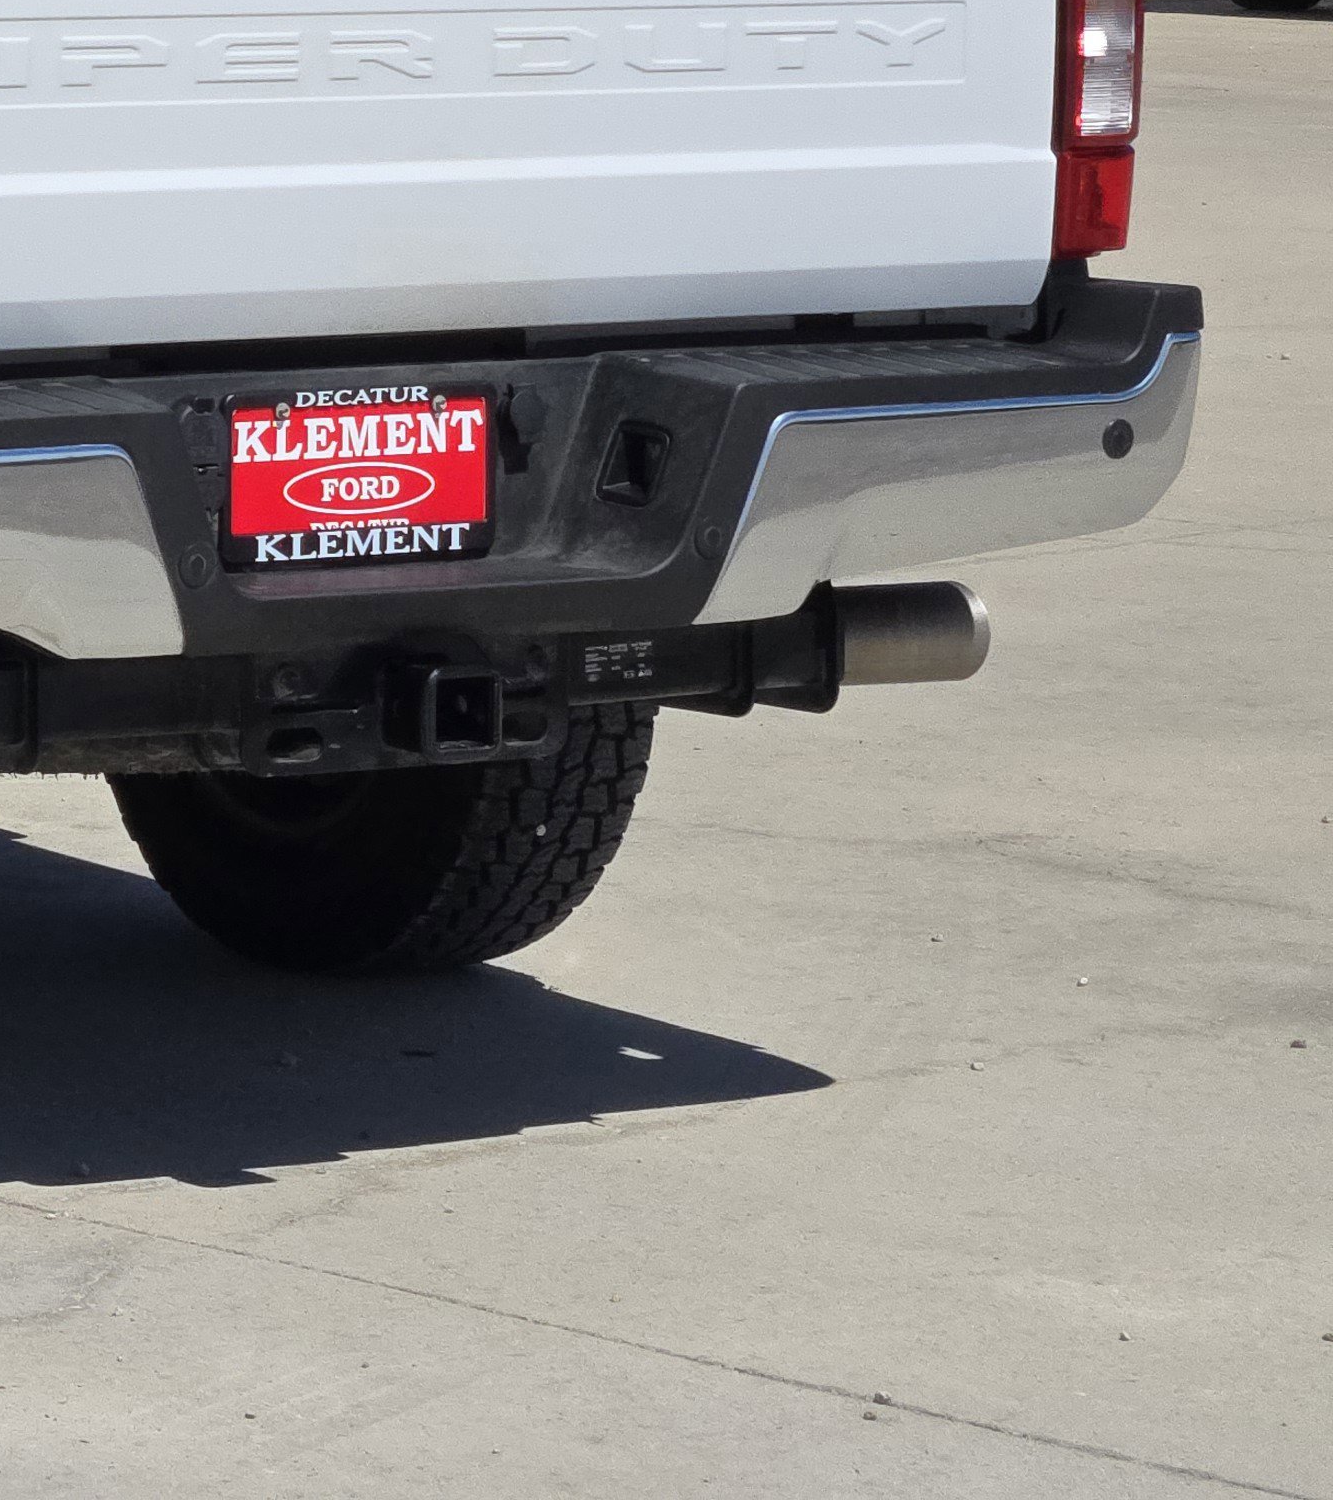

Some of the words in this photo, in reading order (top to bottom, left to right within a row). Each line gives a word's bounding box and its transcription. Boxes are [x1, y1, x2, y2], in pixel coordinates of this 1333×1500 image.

[492, 16, 946, 78] DUTY
[294, 385, 430, 408] DECATUR
[233, 409, 483, 463] KLEMENT
[320, 475, 400, 502] FORD
[255, 523, 470, 562] KLEMENT
